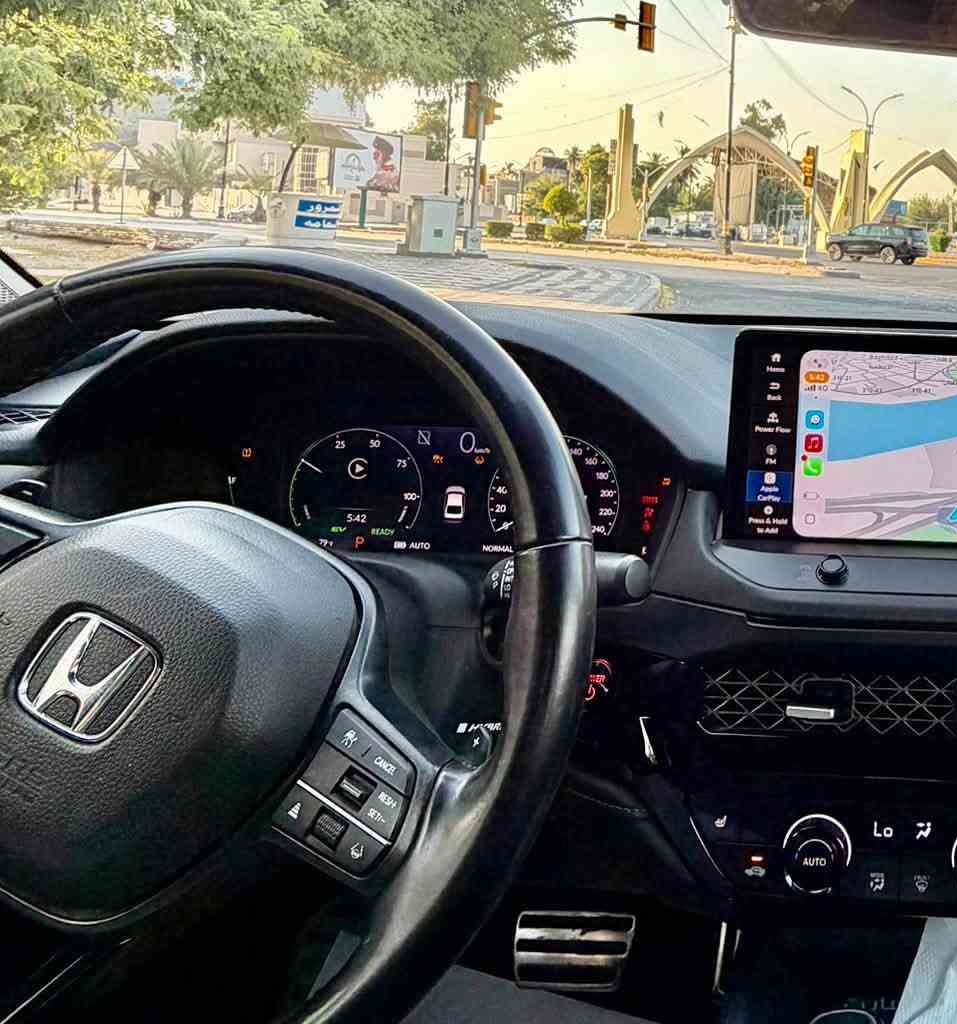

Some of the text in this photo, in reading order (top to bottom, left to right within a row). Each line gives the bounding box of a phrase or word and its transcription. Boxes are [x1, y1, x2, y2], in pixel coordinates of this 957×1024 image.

[766, 365, 785, 373] Home
[754, 425, 775, 433] Power
[334, 440, 346, 449] 25
[368, 439, 381, 448] 50
[460, 431, 476, 454] 0
[396, 458, 408, 468] 75
[584, 457, 598, 465] 160
[595, 472, 609, 480] 180
[496, 486, 508, 494] 40
[600, 489, 614, 497] 200
[760, 485, 780, 493] Apple
[403, 492, 417, 501] 100
[757, 494, 781, 503] CarPlay
[495, 503, 507, 513] 20
[598, 508, 613, 516] 220
[346, 513, 367, 523] 5:42
[748, 517, 765, 525] Press
[772, 517, 789, 525] Hold
[371, 527, 395, 536] READY
[409, 540, 431, 550] AUTO
[482, 544, 515, 553] NORMAL
[373, 755, 398, 777] CANCEL
[873, 820, 893, 838] Lo
[802, 857, 827, 867] AUTO
